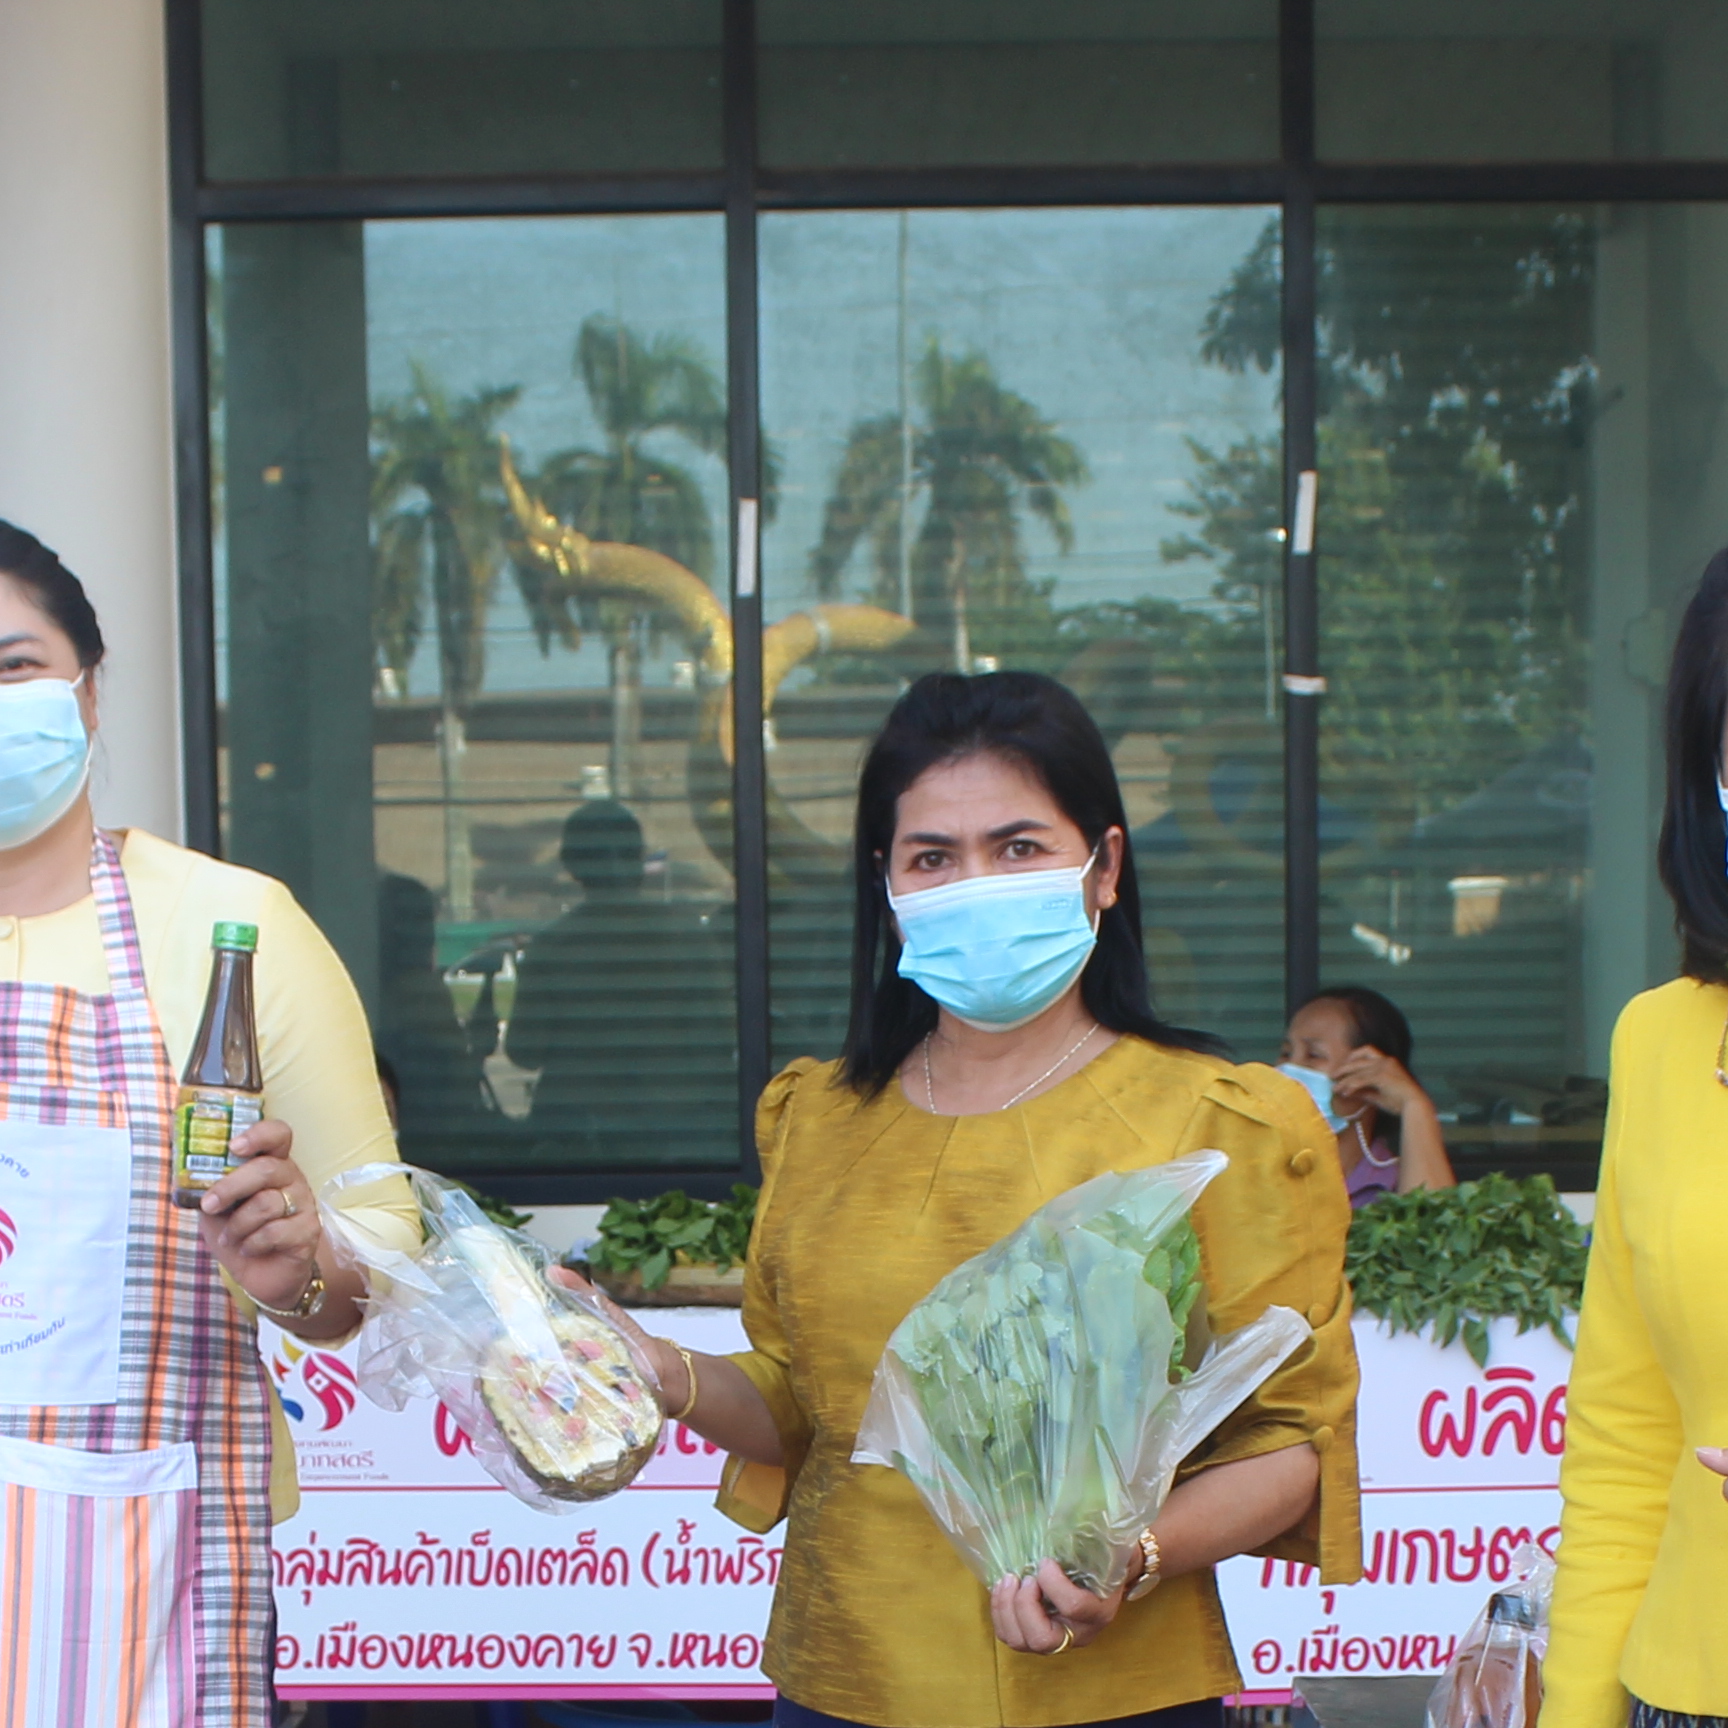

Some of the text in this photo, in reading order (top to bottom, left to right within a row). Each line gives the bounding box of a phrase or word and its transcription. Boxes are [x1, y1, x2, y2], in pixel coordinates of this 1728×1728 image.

[300, 1449, 375, 1468] าทสตรี
[275, 1621, 765, 1670] อ.เมืองหนองคาย จ.หนอ
